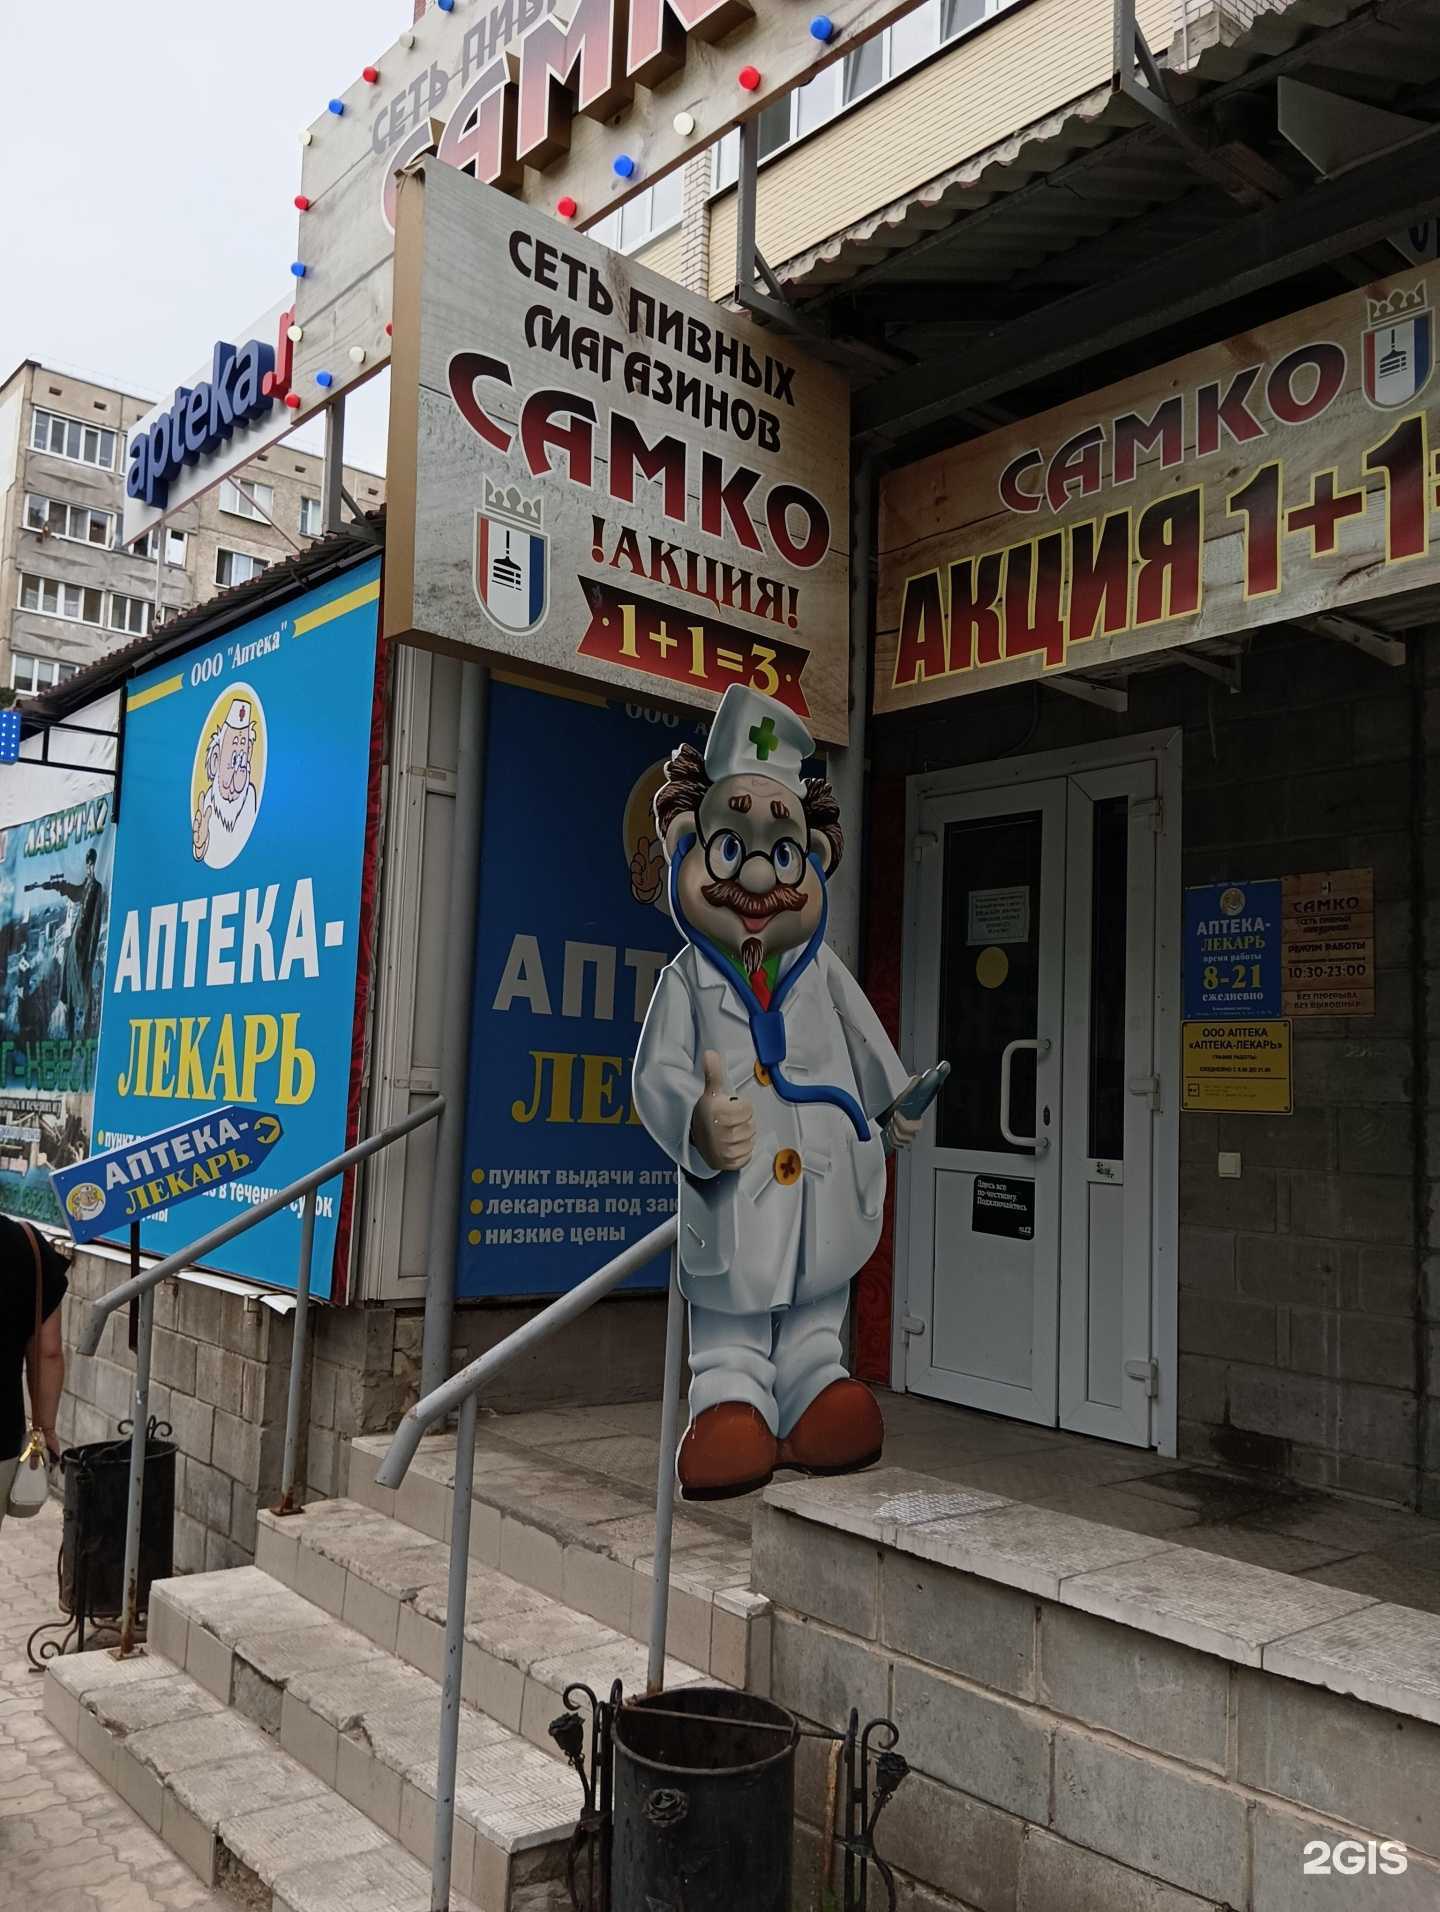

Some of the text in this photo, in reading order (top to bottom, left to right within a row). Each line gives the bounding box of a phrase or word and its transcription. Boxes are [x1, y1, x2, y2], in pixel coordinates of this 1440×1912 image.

[373, 0, 555, 154] СЕТЬ ПИВ
[508, 229, 797, 407] СЕТЬ ПИВНЫХ
[523, 304, 782, 453] МАГАЗИНОВ
[447, 350, 832, 570] САМКО
[999, 341, 1348, 514] САМКО
[591, 514, 801, 630] !АКЦИЯ!
[891, 409, 1440, 689] АКЦИЯ 1+1
[191, 620, 288, 687] ООО "Аптека"
[113, 877, 345, 994] АПТЕКА-
[1196, 917, 1271, 936] АПТЕКА-
[1293, 897, 1360, 913] САМКО
[491, 933, 669, 1024] АПТ
[1201, 935, 1266, 952] ЛЕКАРЬ
[1202, 991, 1264, 1002] ежедневно
[1202, 1027, 1269, 1038] ООО АПТЕКА
[117, 1011, 317, 1106] ЛЕКАРЬ
[511, 1050, 642, 1125] ЛЕ
[104, 1118, 250, 1191] АПТЕКА-
[125, 1147, 252, 1216] ЛЕКАРЬ
[488, 1168, 551, 1188] пункт
[555, 1168, 634, 1188] выдачи
[290, 1194, 333, 1219] суок
[485, 1225, 626, 1246] низкие цены
[486, 1198, 600, 1218] лекарства
[605, 1198, 641, 1216] под
